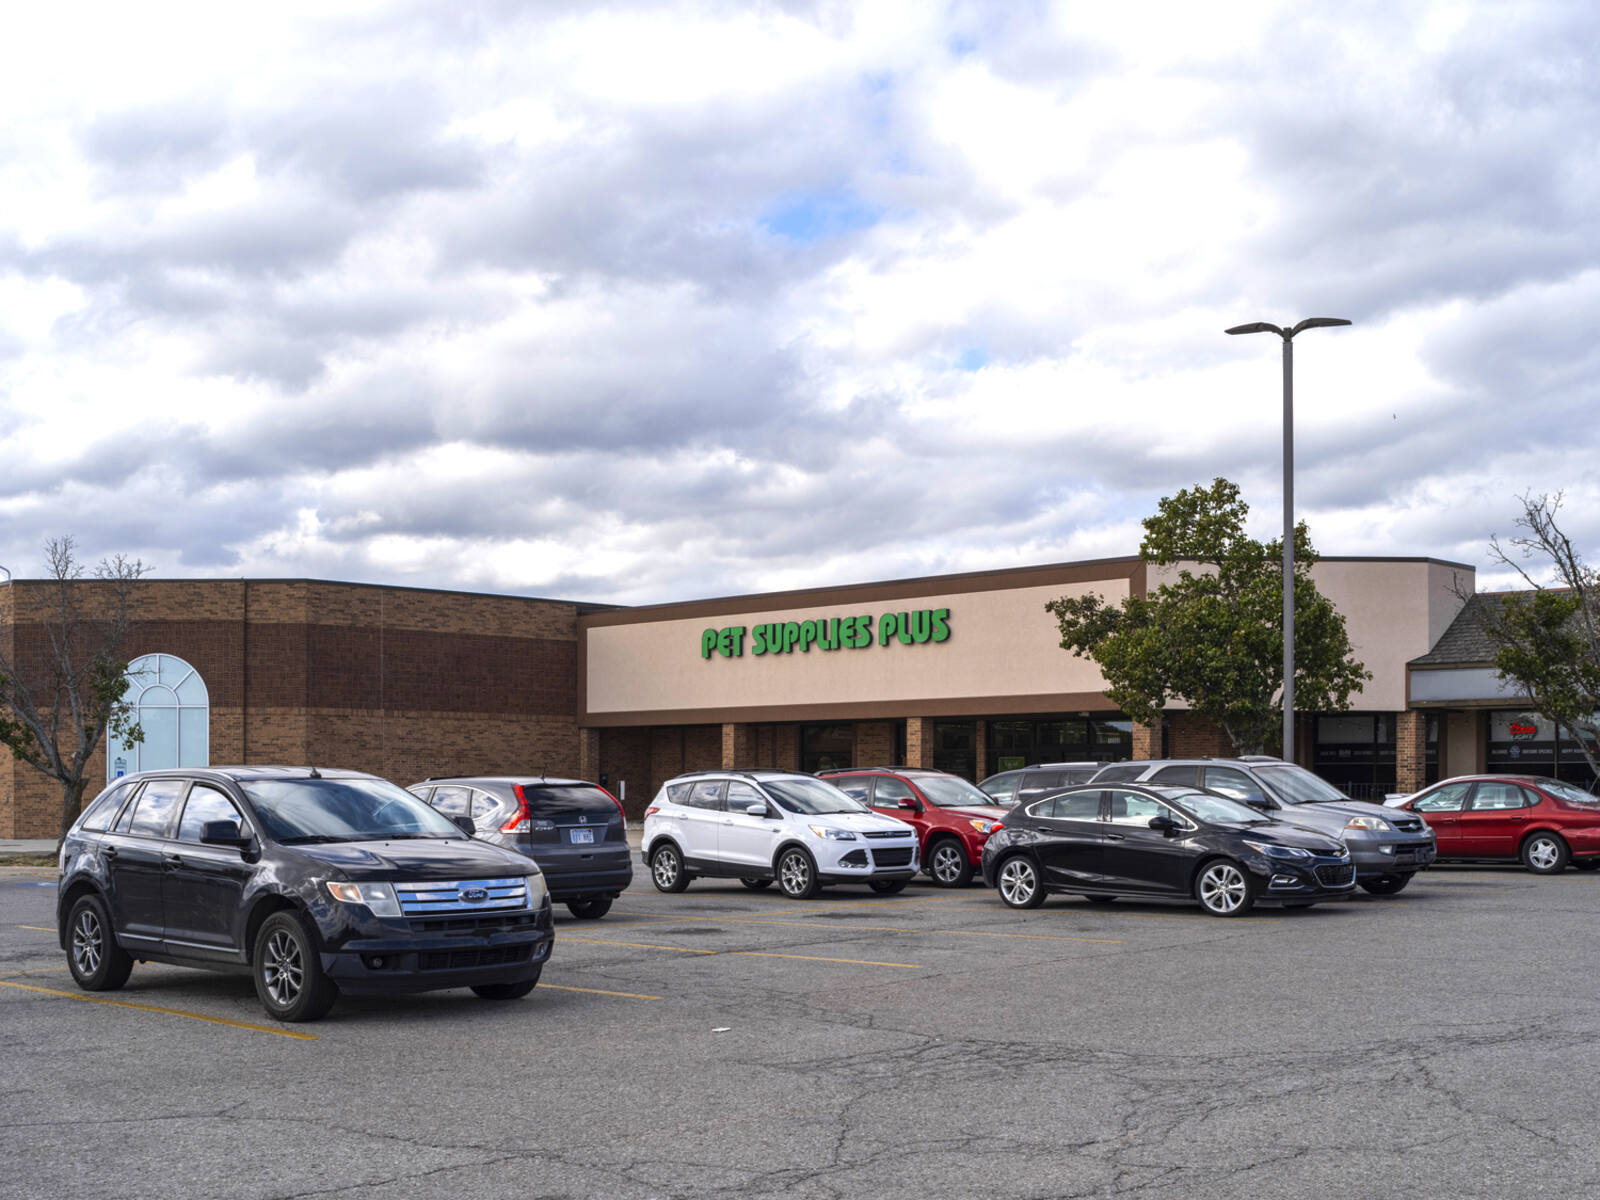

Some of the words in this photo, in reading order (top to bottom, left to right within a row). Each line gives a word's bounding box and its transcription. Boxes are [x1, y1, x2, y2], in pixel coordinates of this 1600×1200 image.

[702, 626, 745, 658] PET
[752, 615, 872, 655] SUPPLIES
[879, 608, 950, 646] PLUS
[1509, 721, 1536, 735] Coors
